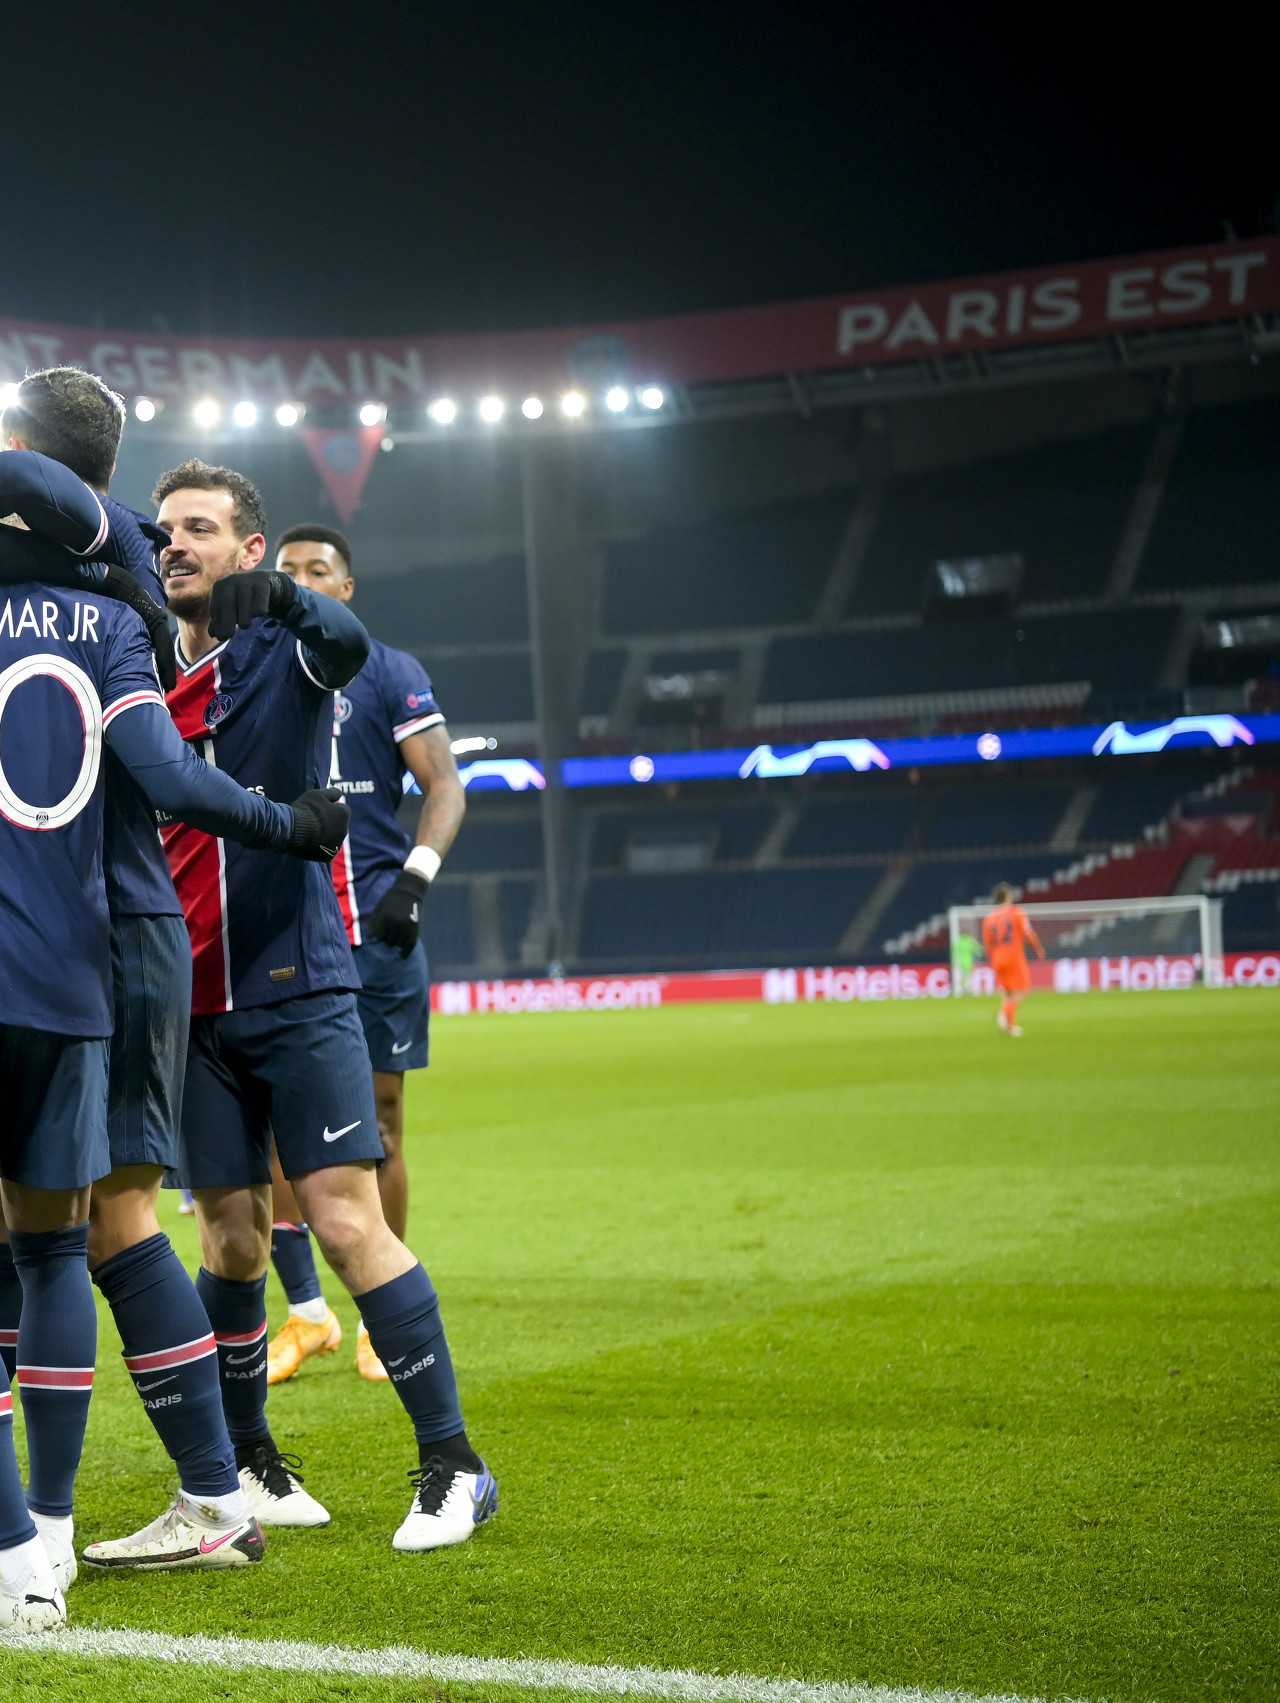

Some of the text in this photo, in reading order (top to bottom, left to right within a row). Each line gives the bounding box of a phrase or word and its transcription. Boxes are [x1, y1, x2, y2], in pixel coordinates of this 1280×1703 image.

[837, 253, 1267, 355] PARIS EST
[67, 602, 100, 643] JR
[476, 977, 662, 1013] Hotels.com
[225, 1360, 266, 1379] PARIS
[393, 1354, 435, 1382] PARIS
[142, 1393, 183, 1410] PARIS
